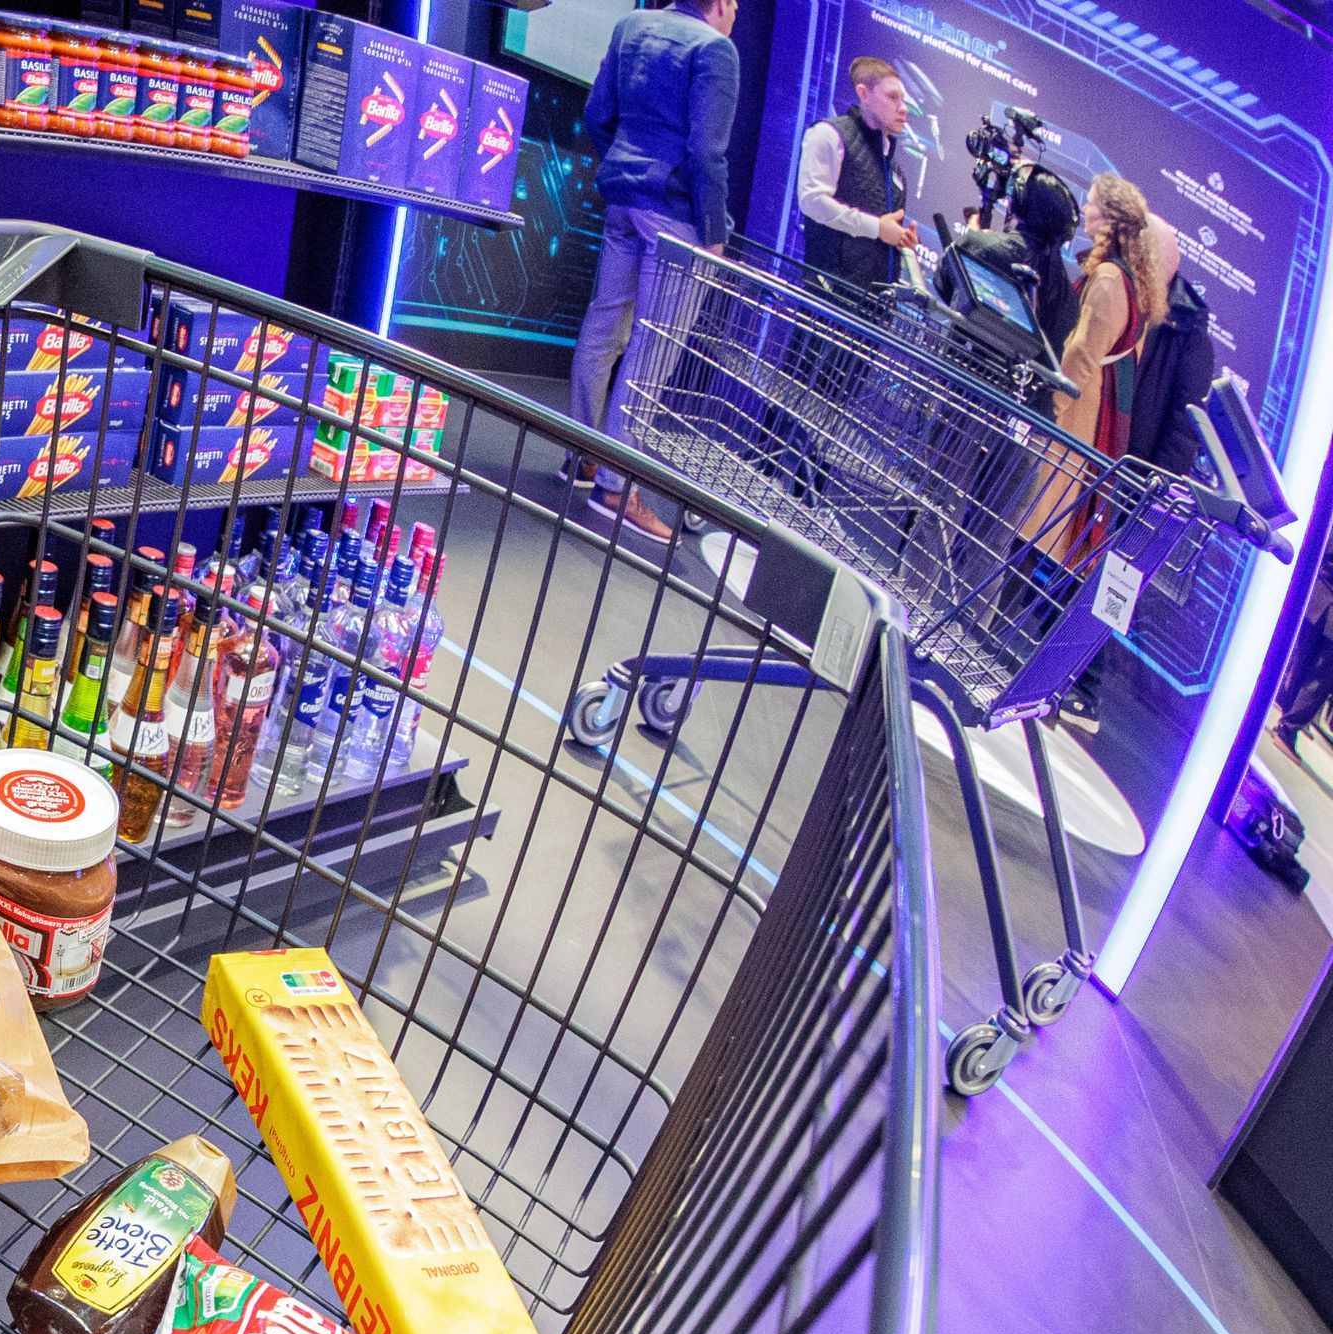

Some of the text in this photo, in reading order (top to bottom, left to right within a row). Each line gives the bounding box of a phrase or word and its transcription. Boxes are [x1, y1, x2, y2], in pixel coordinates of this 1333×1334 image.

[251, 70, 278, 86] arilla
[366, 100, 402, 121] Barilla
[424, 116, 455, 135] Barilla
[483, 132, 510, 150] Barilla
[43, 333, 89, 349] Bailla
[199, 336, 239, 347] SPGHETTI
[248, 339, 283, 354] Brilla
[192, 393, 231, 404] SGHETTI
[185, 450, 223, 460] SAGHETTI
[233, 449, 267, 464] Brilla
[136, 725, 164, 749] Bols
[211, 1007, 270, 1128] KEKS
[342, 1049, 461, 1201] LEIBNIZ
[269, 1125, 297, 1180] Original
[137, 1180, 184, 1214] Blütenhonig
[100, 1216, 173, 1257] Biene
[86, 1228, 150, 1269] Flotte
[420, 1262, 480, 1278] ORIGINAL
